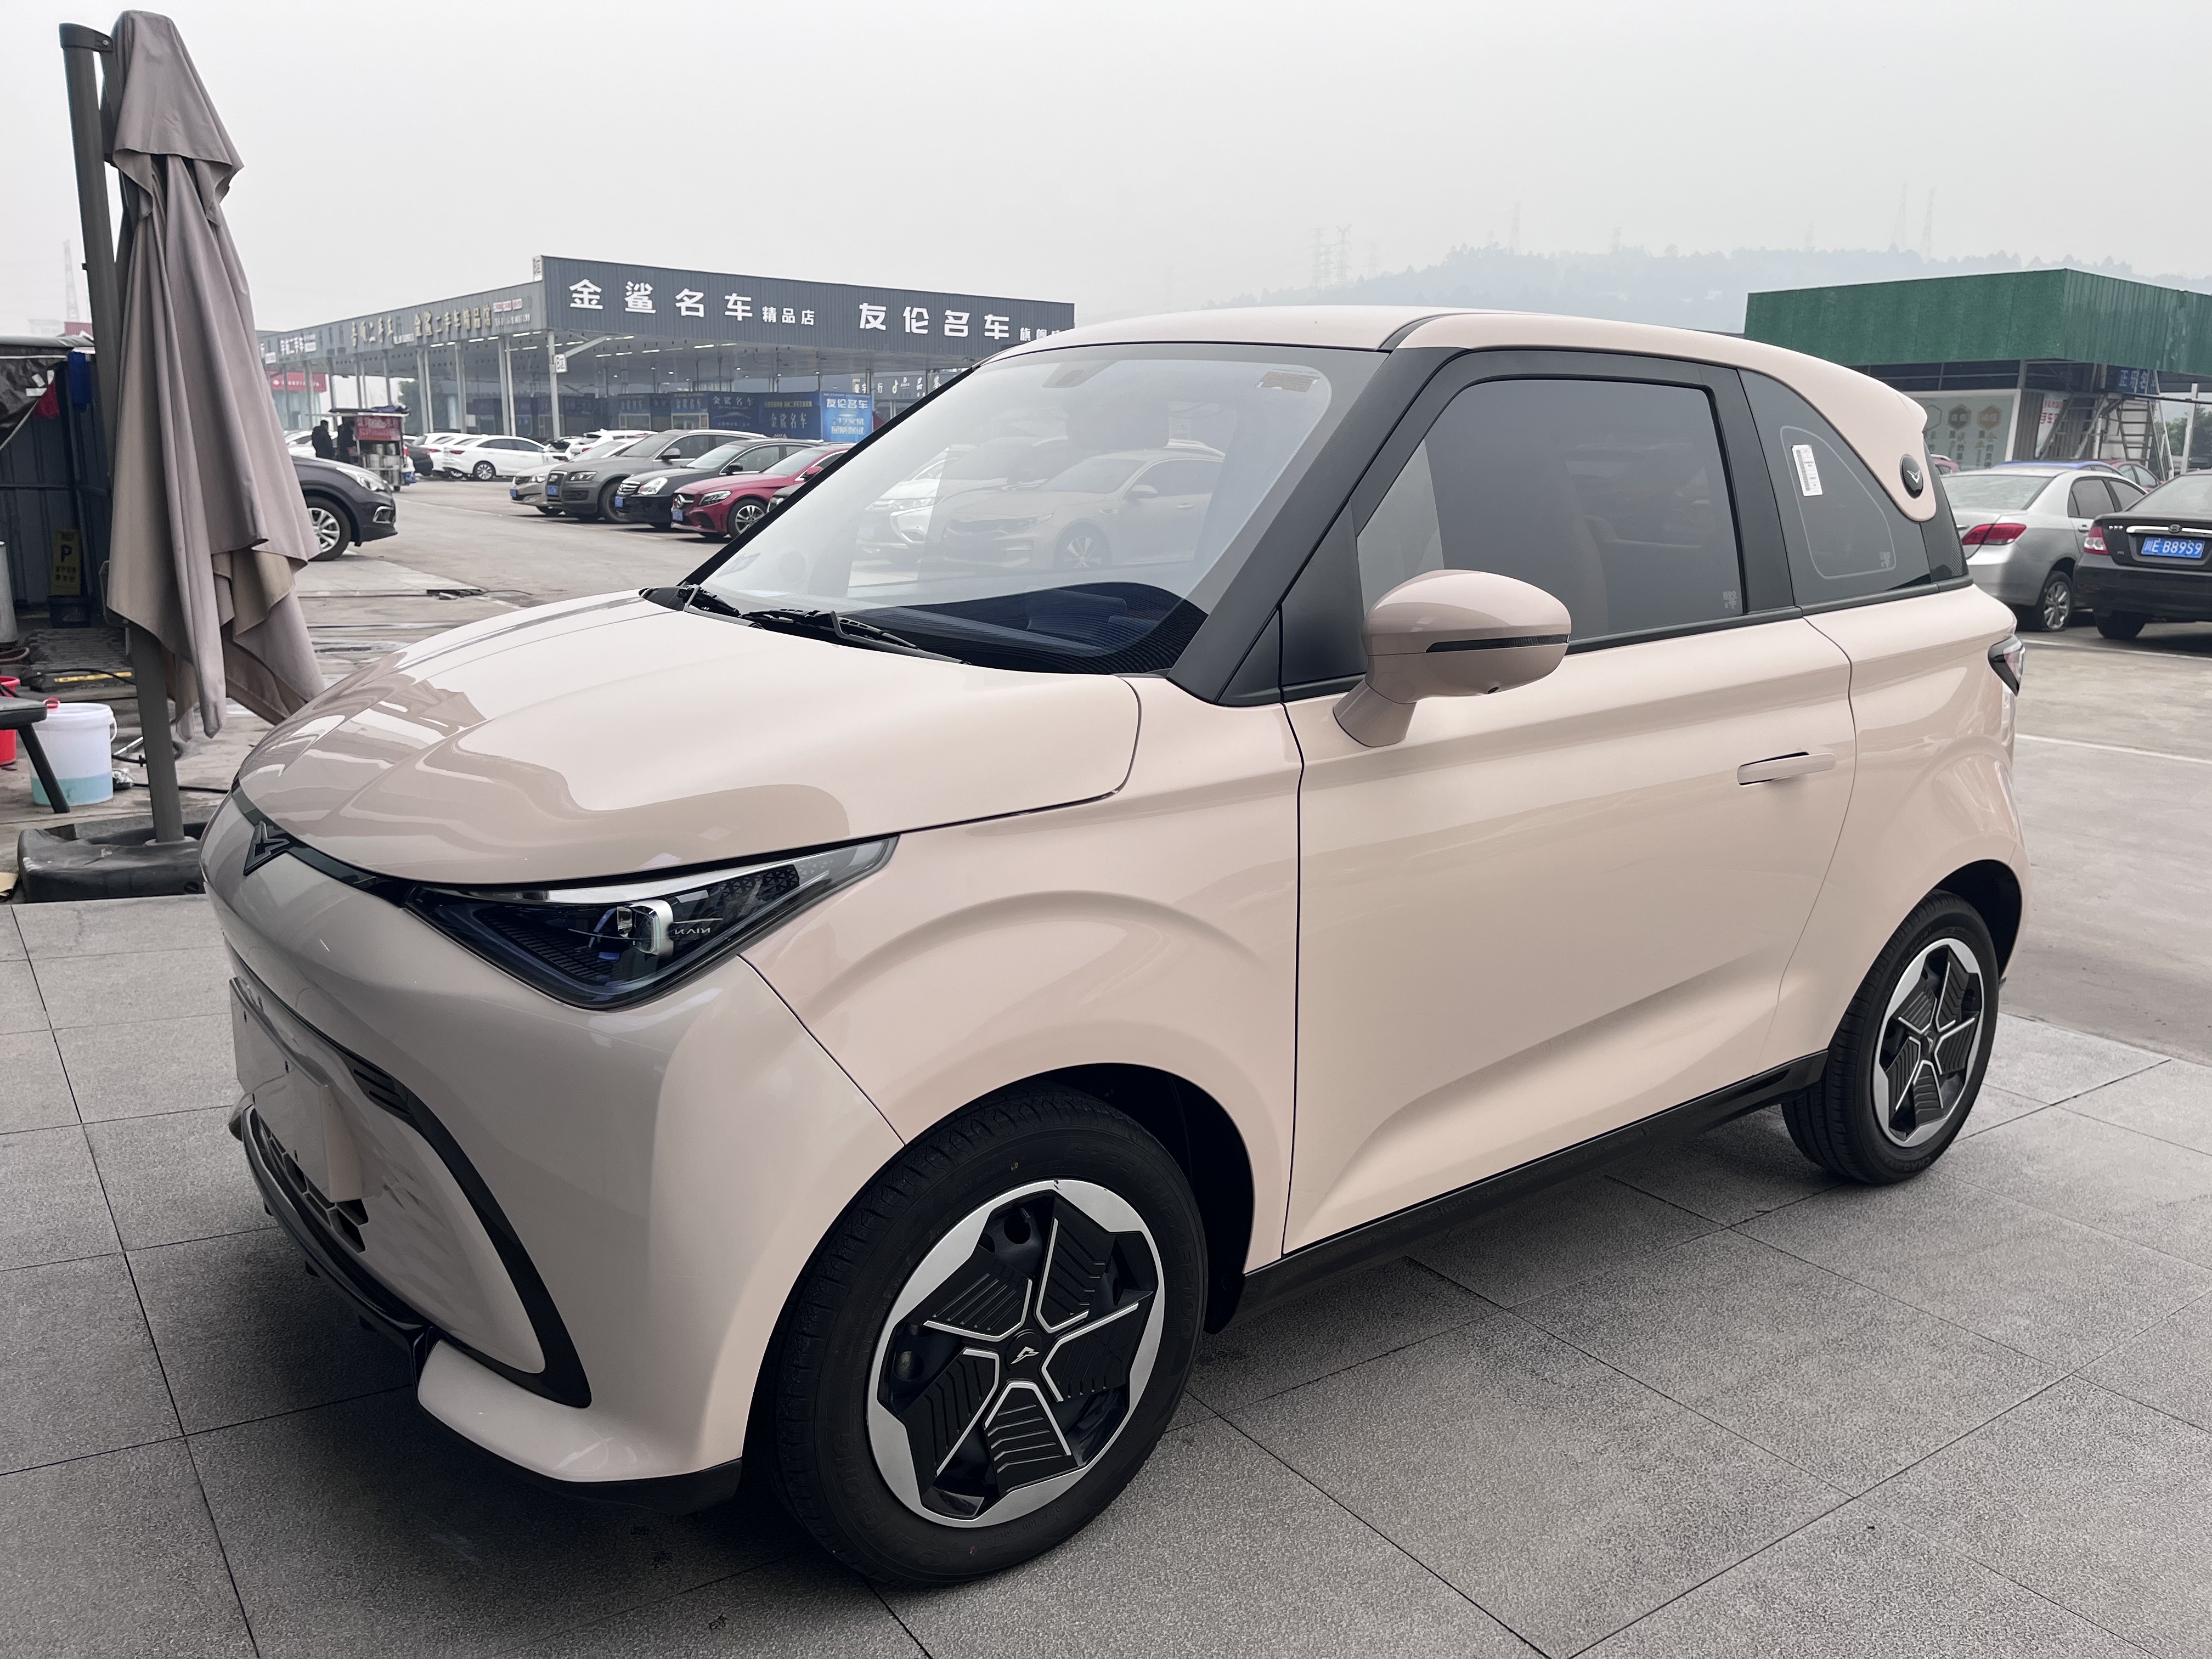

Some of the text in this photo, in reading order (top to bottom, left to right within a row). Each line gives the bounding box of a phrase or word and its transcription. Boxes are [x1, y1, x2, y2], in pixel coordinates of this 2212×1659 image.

[569, 279, 816, 326] 金鲨名车 精品店
[858, 302, 1060, 341] 友伦名车 旗舰
[826, 398, 868, 409] 友伦名车
[61, 544, 72, 562] P
